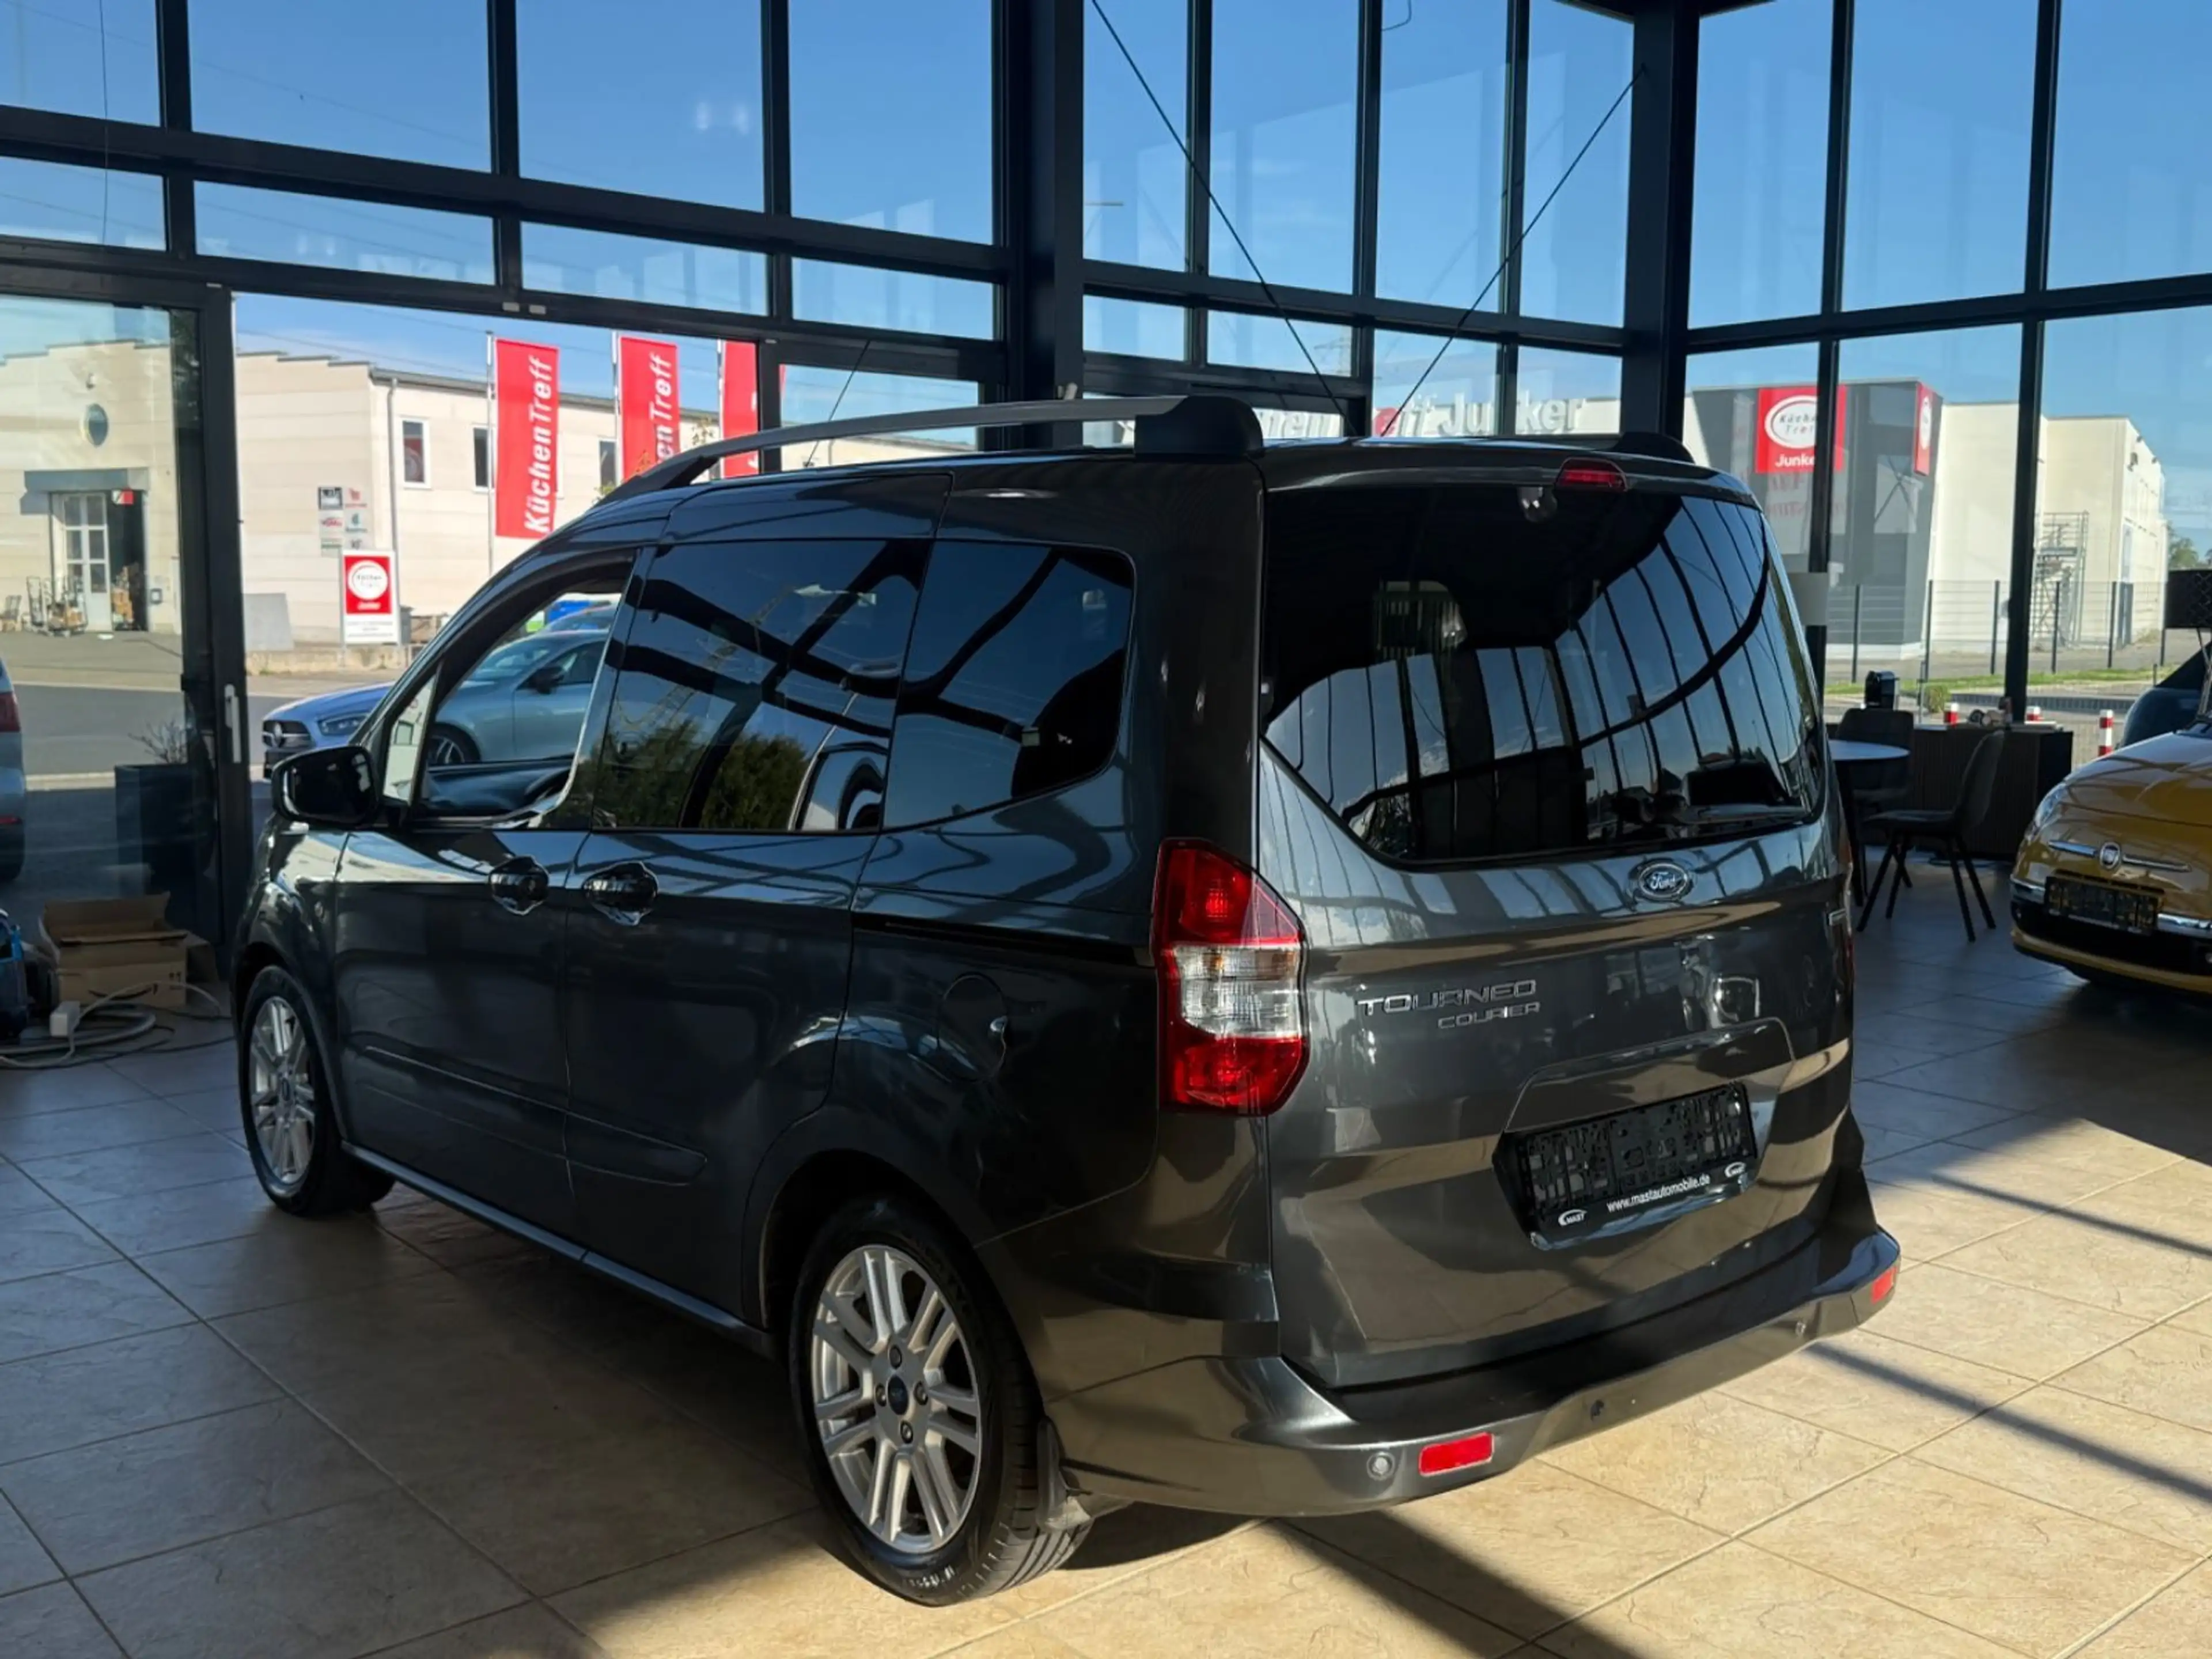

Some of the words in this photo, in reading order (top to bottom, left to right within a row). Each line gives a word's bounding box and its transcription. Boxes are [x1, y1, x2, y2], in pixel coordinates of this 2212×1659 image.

[1438, 389, 1585, 436] Juker
[524, 354, 553, 533] KüchenTreff
[1775, 453, 1816, 467] Junke
[1649, 871, 1679, 890] Ford
[1357, 979, 1536, 1016] TOURNEO
[1438, 1001, 1541, 1029] COURIER
[1607, 1173, 1711, 1213] www.mastautomobile.de
